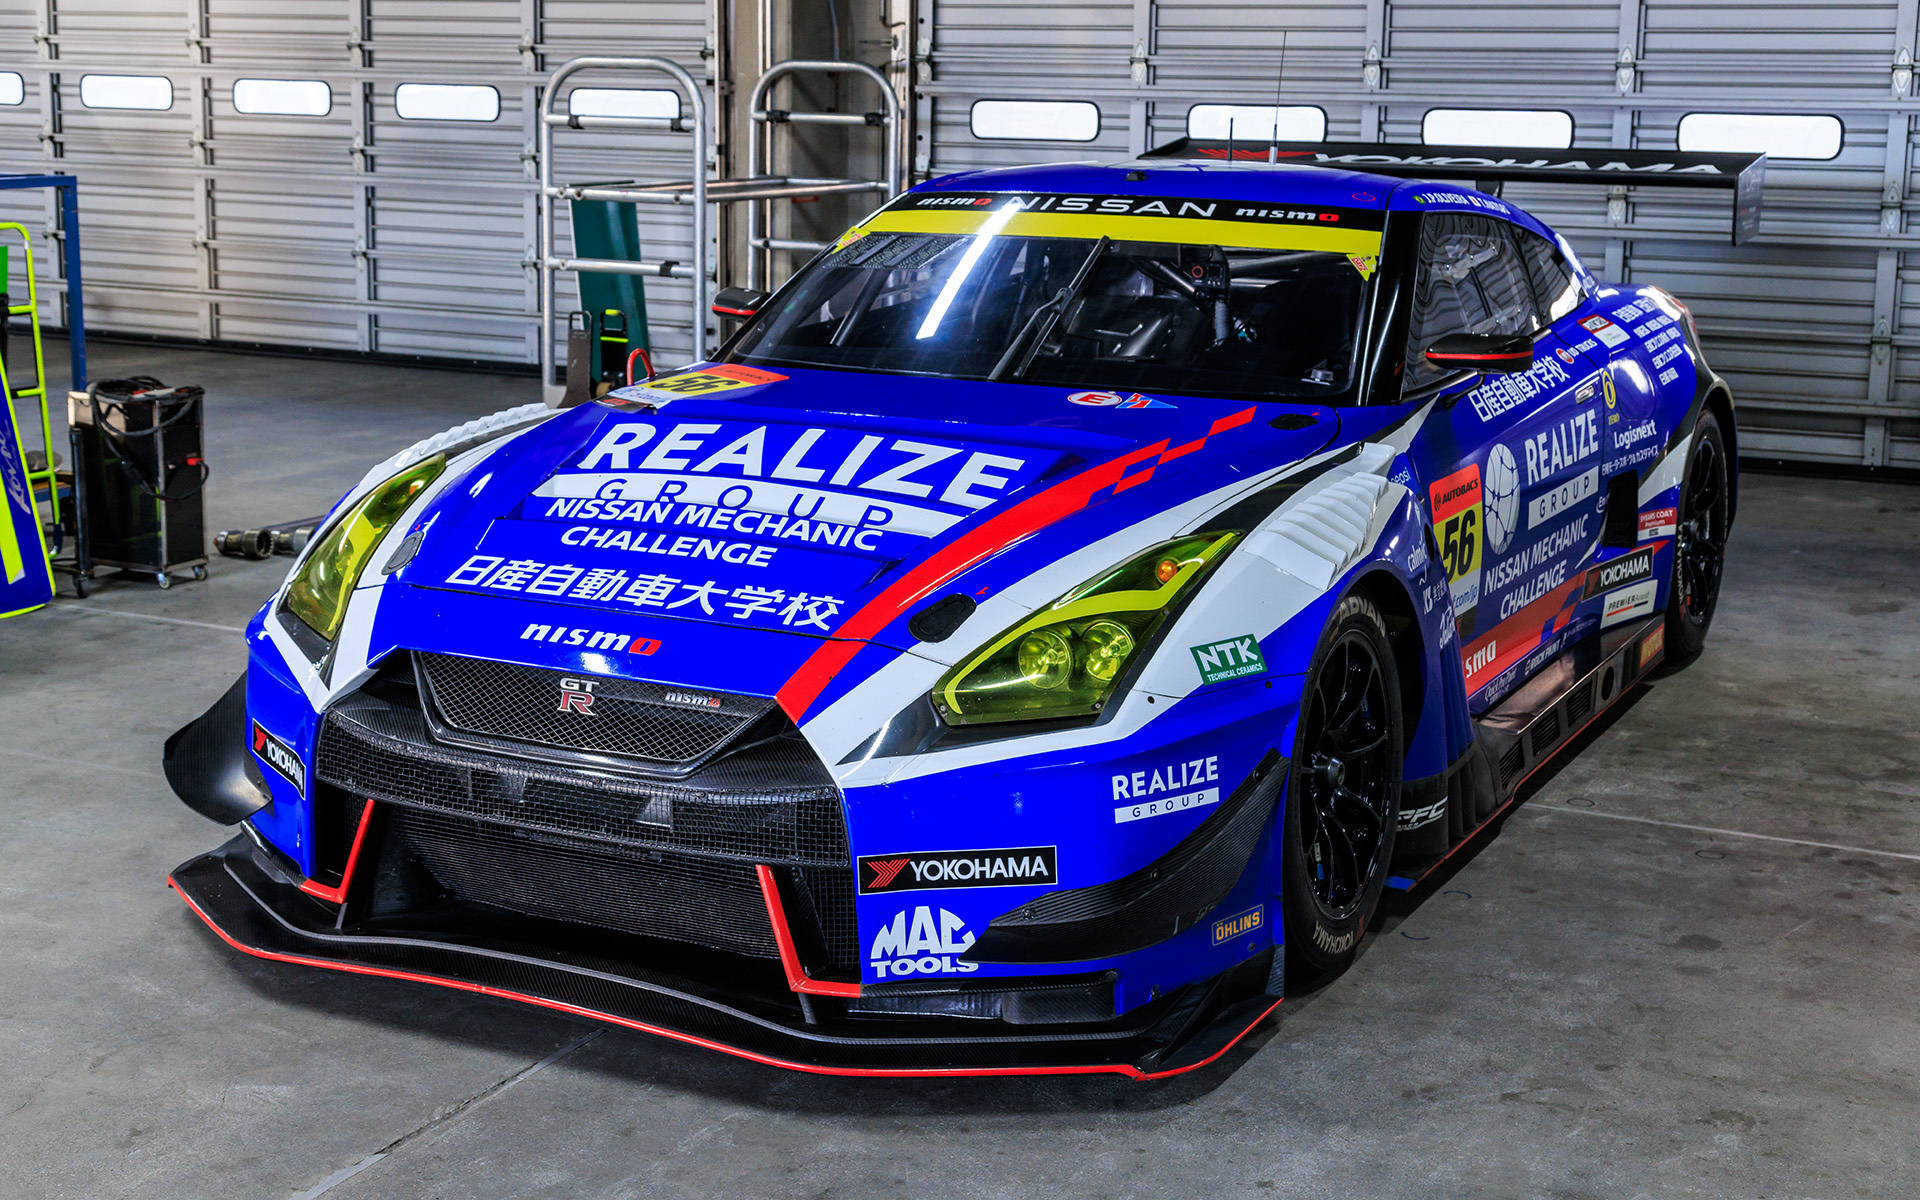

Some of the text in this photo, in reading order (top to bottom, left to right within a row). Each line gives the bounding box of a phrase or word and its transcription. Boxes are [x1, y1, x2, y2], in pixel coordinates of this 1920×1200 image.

[1315, 153, 1722, 174] YOKOHAMA
[916, 196, 1340, 222] nismo NISSAN nismo
[650, 374, 741, 393] 56
[1468, 355, 1570, 422] 日産自動車大学校
[1524, 408, 1599, 486] REALIZE
[1614, 419, 1657, 449] Logisnext
[577, 423, 1025, 510] REALIZE
[596, 478, 893, 527] GROUP
[1442, 478, 1479, 504] AUTOBACS
[1539, 475, 1590, 519] GROUP
[545, 498, 883, 552] NISSAN MECHANIC
[1656, 509, 1674, 518] COAT
[561, 526, 778, 568] CHALLENGE
[1443, 509, 1476, 584] 56
[1484, 547, 1530, 597] NISSAN
[1530, 513, 1589, 570] MECHANIC
[1600, 555, 1650, 587] YOKOHAMA
[445, 555, 845, 631] 日産自動車大学校
[1500, 559, 1567, 620] CHALLENGE
[1608, 595, 1636, 611] PREMIER
[520, 623, 662, 656] nismo
[1196, 637, 1258, 672] NTK
[559, 677, 600, 692] GT
[1207, 662, 1263, 682] TECHNICAL CERAMICS
[557, 690, 598, 717] R
[665, 691, 723, 709] nismo
[266, 737, 304, 790] YOKOHAM
[1112, 755, 1219, 800] REALIZE
[1132, 793, 1205, 818] GROUP
[910, 855, 1049, 882] YOKOHAMA
[870, 905, 976, 960] MAC
[1216, 911, 1260, 941] ÖHLINS
[1312, 920, 1354, 955] YOKOHAMA
[870, 956, 979, 978] TOOLS
